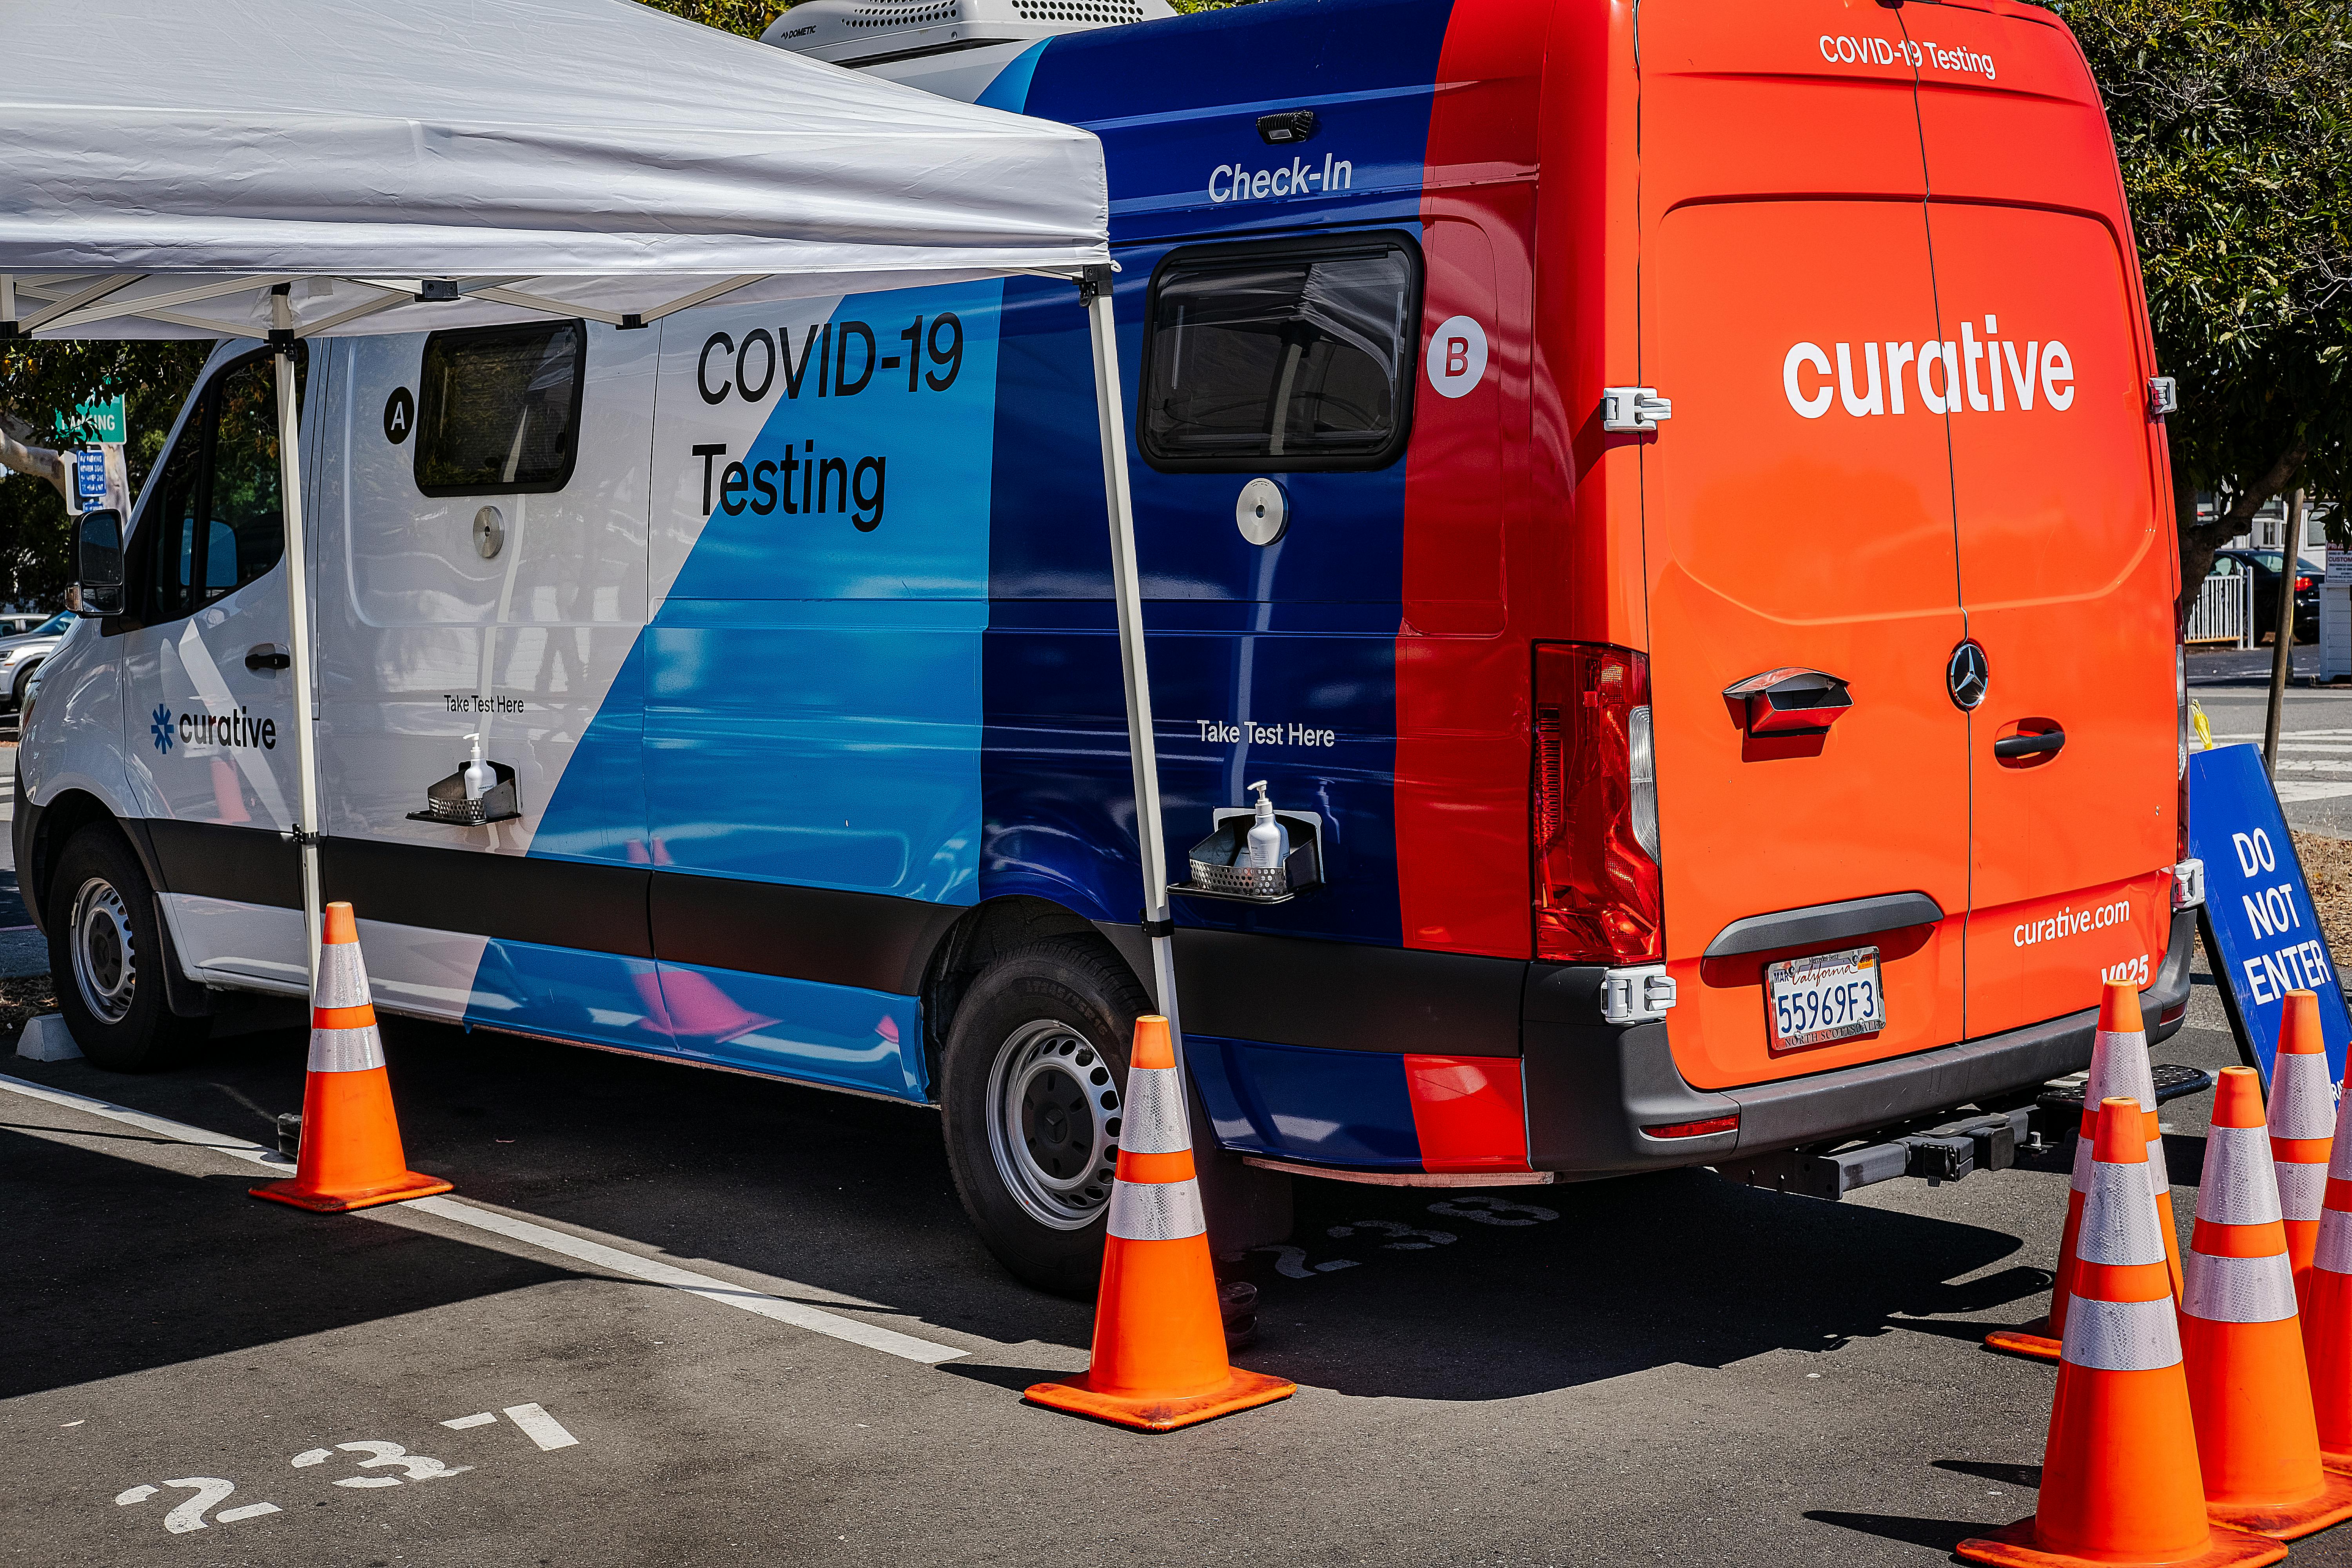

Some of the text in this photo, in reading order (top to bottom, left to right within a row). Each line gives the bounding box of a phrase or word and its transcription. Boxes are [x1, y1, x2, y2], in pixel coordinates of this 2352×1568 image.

[788, 25, 817, 39] DOMETIC
[1820, 35, 1996, 80] COVID-19 Testing
[1208, 152, 1352, 203] Check-In
[697, 312, 964, 405] COVID-19
[1445, 337, 1469, 377] B
[1783, 314, 2075, 419] curative
[62, 414, 115, 431] KING
[391, 401, 405, 430] A
[692, 439, 886, 533] Testing
[444, 695, 524, 713] Take Test Here
[179, 706, 276, 750] curative
[1197, 720, 1335, 747] Take Test Here
[2232, 828, 2275, 877] DO
[2013, 900, 2129, 947] curative.com
[2243, 883, 2301, 940] NOT
[1774, 971, 1789, 984] MAR
[1792, 963, 1858, 987] California
[1809, 954, 1839, 964] Mercedes-Benz
[2243, 939, 2332, 1005] ENTER
[1778, 980, 1874, 1033] 55969F3
[1785, 1031, 1817, 1047] NORTH
[1219, 1196, 1560, 1278] 238
[115, 1403, 580, 1534] 237
